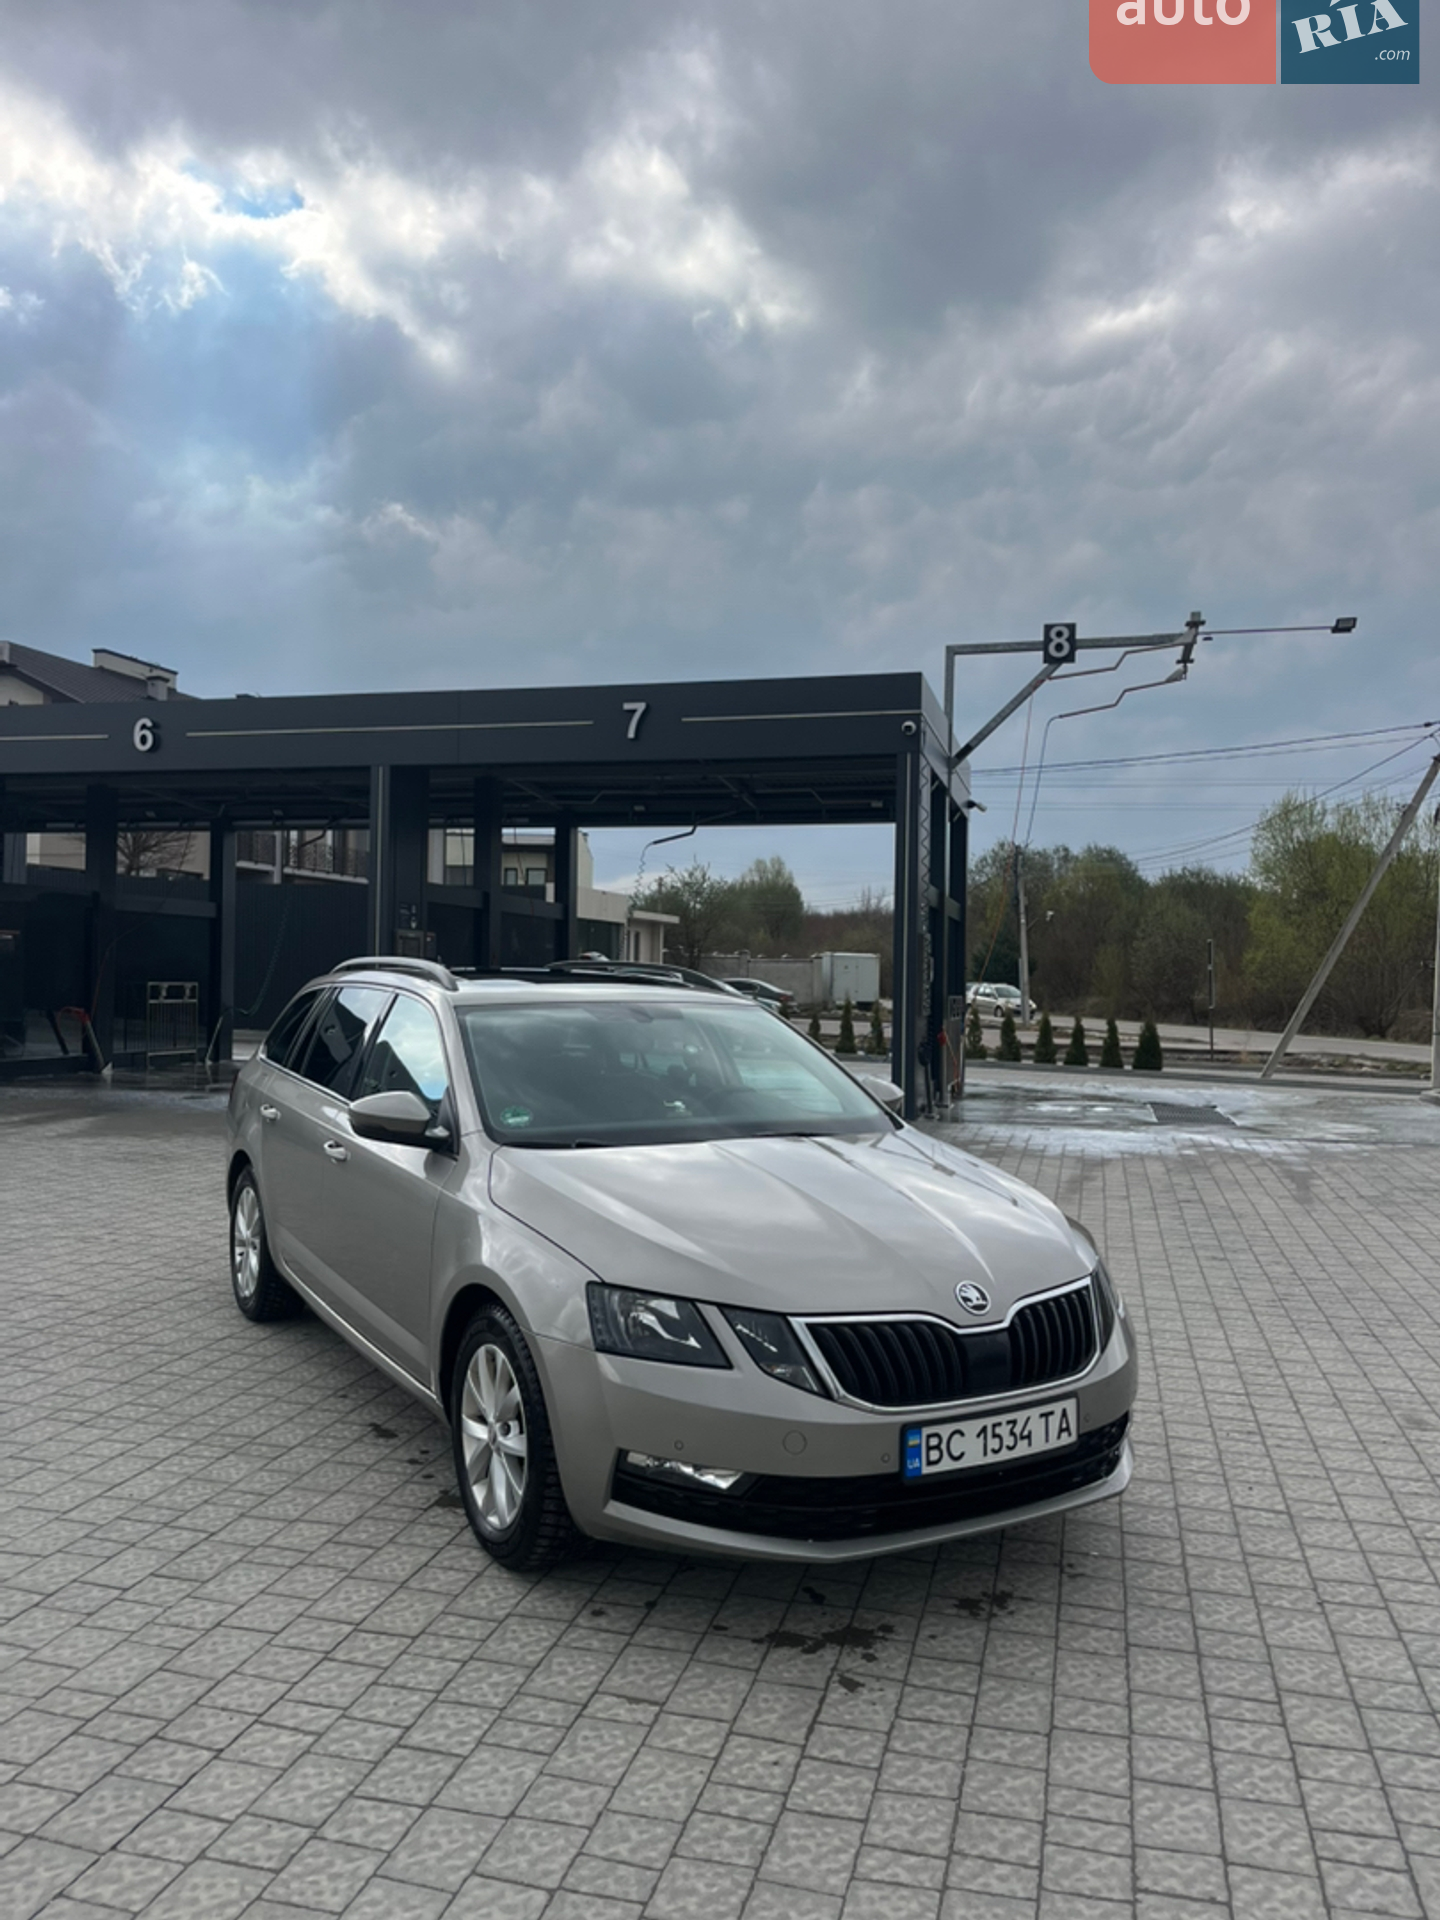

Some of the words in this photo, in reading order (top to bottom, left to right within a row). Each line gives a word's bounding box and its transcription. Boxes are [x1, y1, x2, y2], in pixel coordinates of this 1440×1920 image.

[1049, 625, 1071, 658] 8
[133, 717, 154, 752] 6
[622, 701, 647, 739] 7
[925, 1429, 966, 1467] BC
[975, 1416, 1033, 1458] 1534
[1039, 1407, 1073, 1443] TA
[906, 1457, 921, 1470] UA
